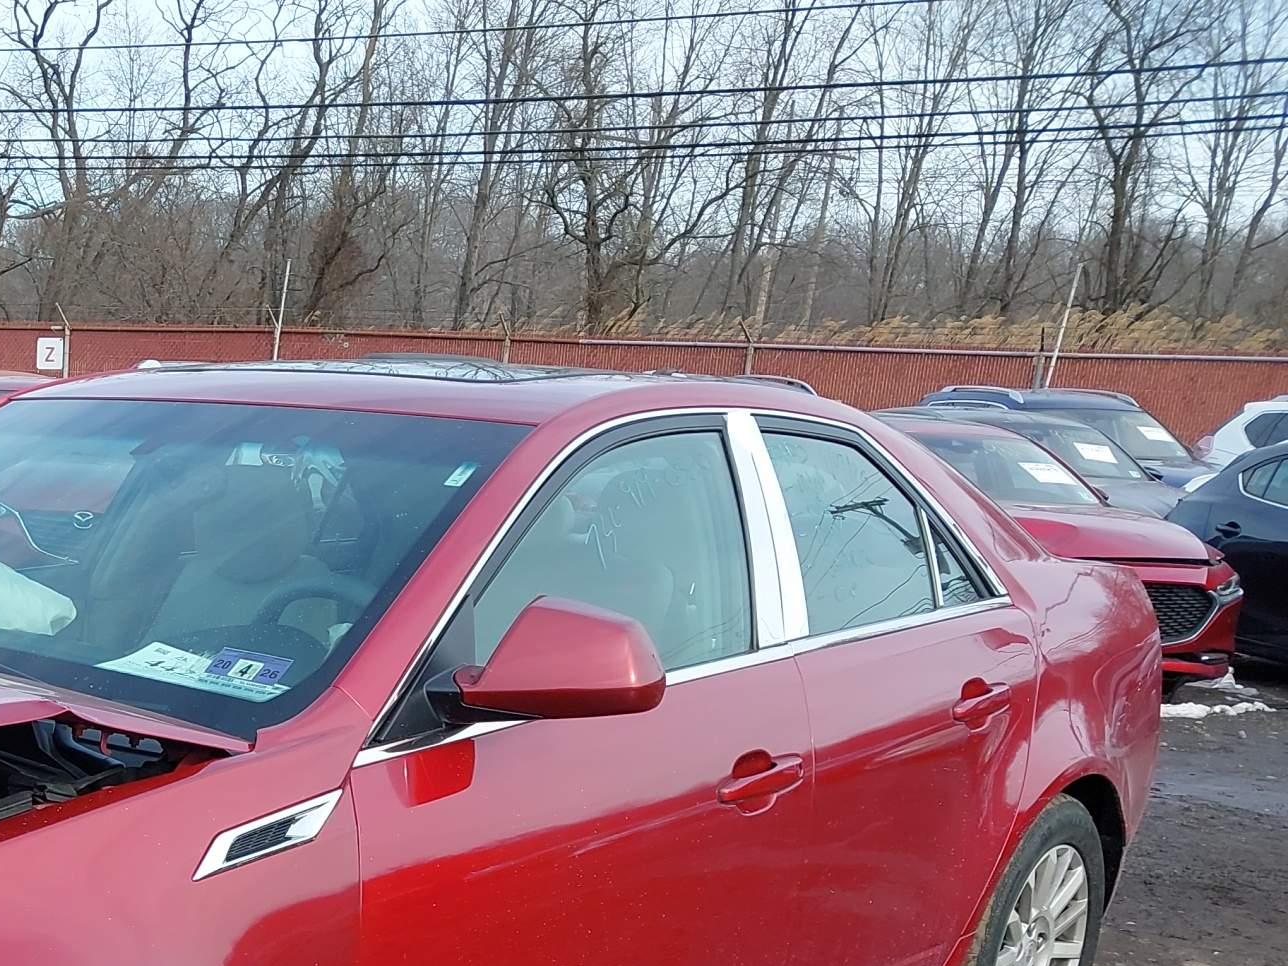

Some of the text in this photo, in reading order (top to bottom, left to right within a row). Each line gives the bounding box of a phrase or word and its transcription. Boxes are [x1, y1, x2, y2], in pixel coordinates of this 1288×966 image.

[45, 347, 55, 362] Z
[213, 659, 280, 679] 20 4 26
